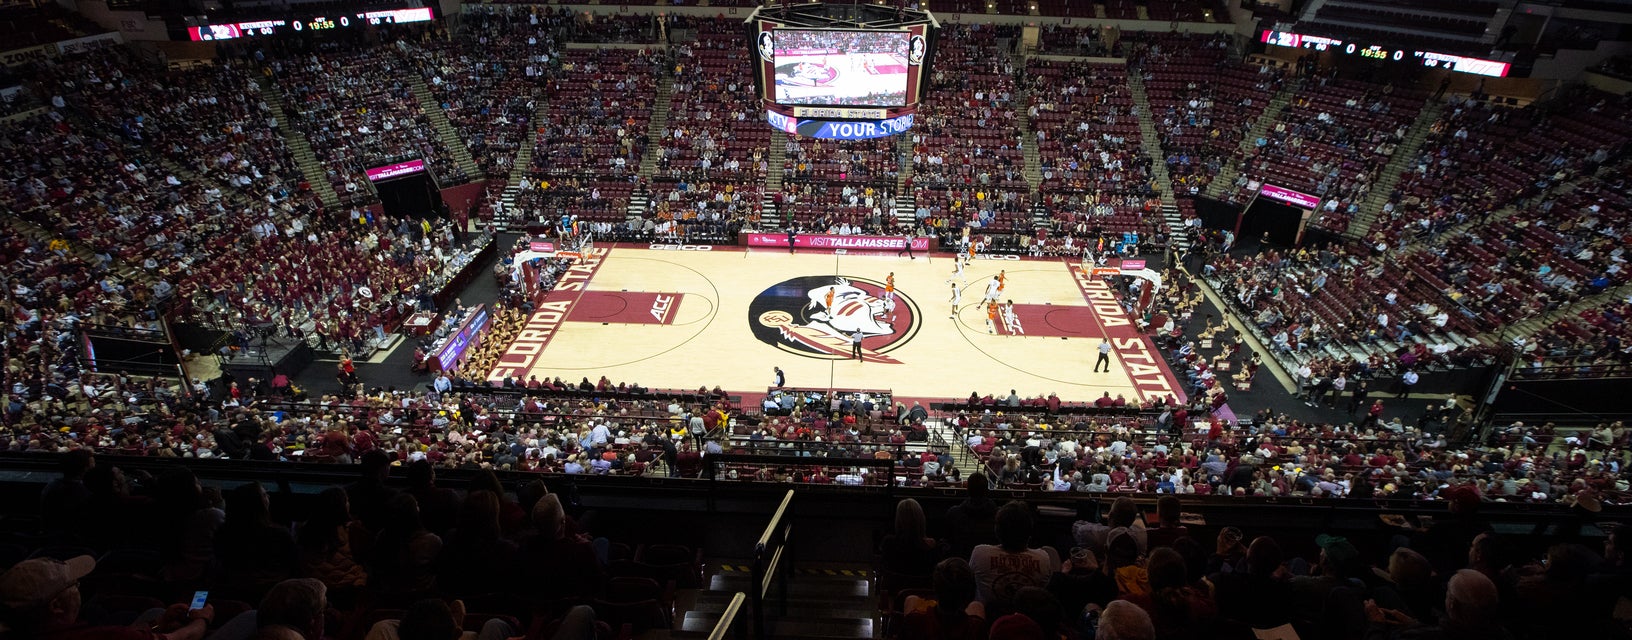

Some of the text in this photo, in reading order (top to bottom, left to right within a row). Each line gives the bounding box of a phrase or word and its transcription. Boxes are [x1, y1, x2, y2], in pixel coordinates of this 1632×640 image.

[293, 20, 302, 31] 0
[308, 20, 335, 30] 19:55
[340, 16, 349, 26] 0
[247, 27, 273, 36] 4 00
[1315, 43, 1327, 51] 00
[1346, 43, 1356, 54] 0
[4, 49, 46, 64] ZONE
[1360, 47, 1388, 60] 19:55
[1393, 50, 1403, 60] 0
[1424, 59, 1451, 69] 00 4
[800, 108, 881, 118] FLORIDA STATE
[829, 114, 914, 136] YOUR STORIES
[649, 243, 713, 251] GEICO
[650, 293, 671, 321] ACC
